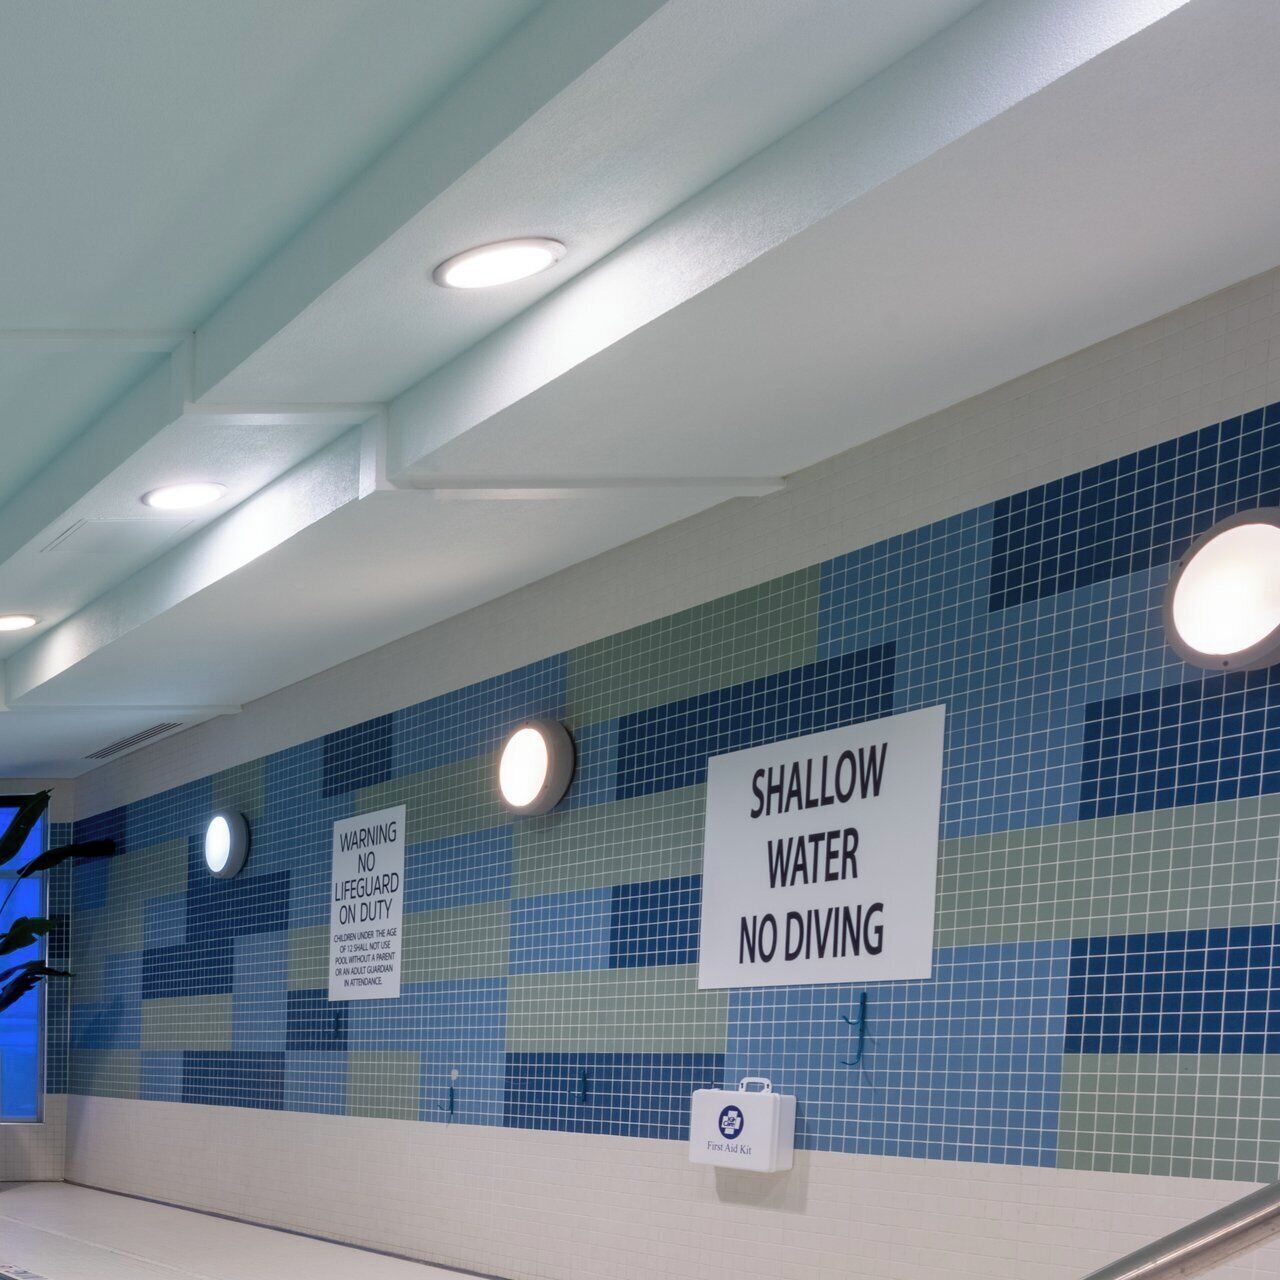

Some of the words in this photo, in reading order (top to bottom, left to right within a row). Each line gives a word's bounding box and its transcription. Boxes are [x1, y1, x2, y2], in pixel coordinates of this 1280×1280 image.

[750, 742, 888, 819] SHALLOW
[339, 821, 397, 852] WARNING
[357, 851, 376, 874] NO
[768, 828, 859, 888] WATER
[335, 872, 399, 901] LIFEGUARD
[339, 902, 356, 925] ON
[360, 898, 393, 922] DUTY
[334, 932, 356, 942] CHILDREN
[357, 931, 374, 941] UNDER
[376, 930, 385, 938] THE
[386, 928, 397, 937] AGE
[740, 913, 778, 964] NO
[785, 902, 884, 961] DIVING
[339, 943, 346, 953] OF
[347, 943, 353, 952] 12
[354, 942, 369, 952] SHALL
[369, 941, 381, 950] NOT
[381, 940, 391, 950] USE
[335, 954, 348, 965] POOL
[348, 953, 371, 964] WITHOUT
[371, 953, 375, 962] A
[376, 952, 396, 962] PARENT
[335, 965, 342, 976] OR
[343, 966, 350, 975] AN
[350, 965, 366, 975] ADULT
[367, 964, 393, 974] GUARDIAN
[344, 978, 349, 987] IN
[707, 1141, 723, 1151] First
[724, 1143, 738, 1154] Aid
[740, 1145, 752, 1155] Kit
